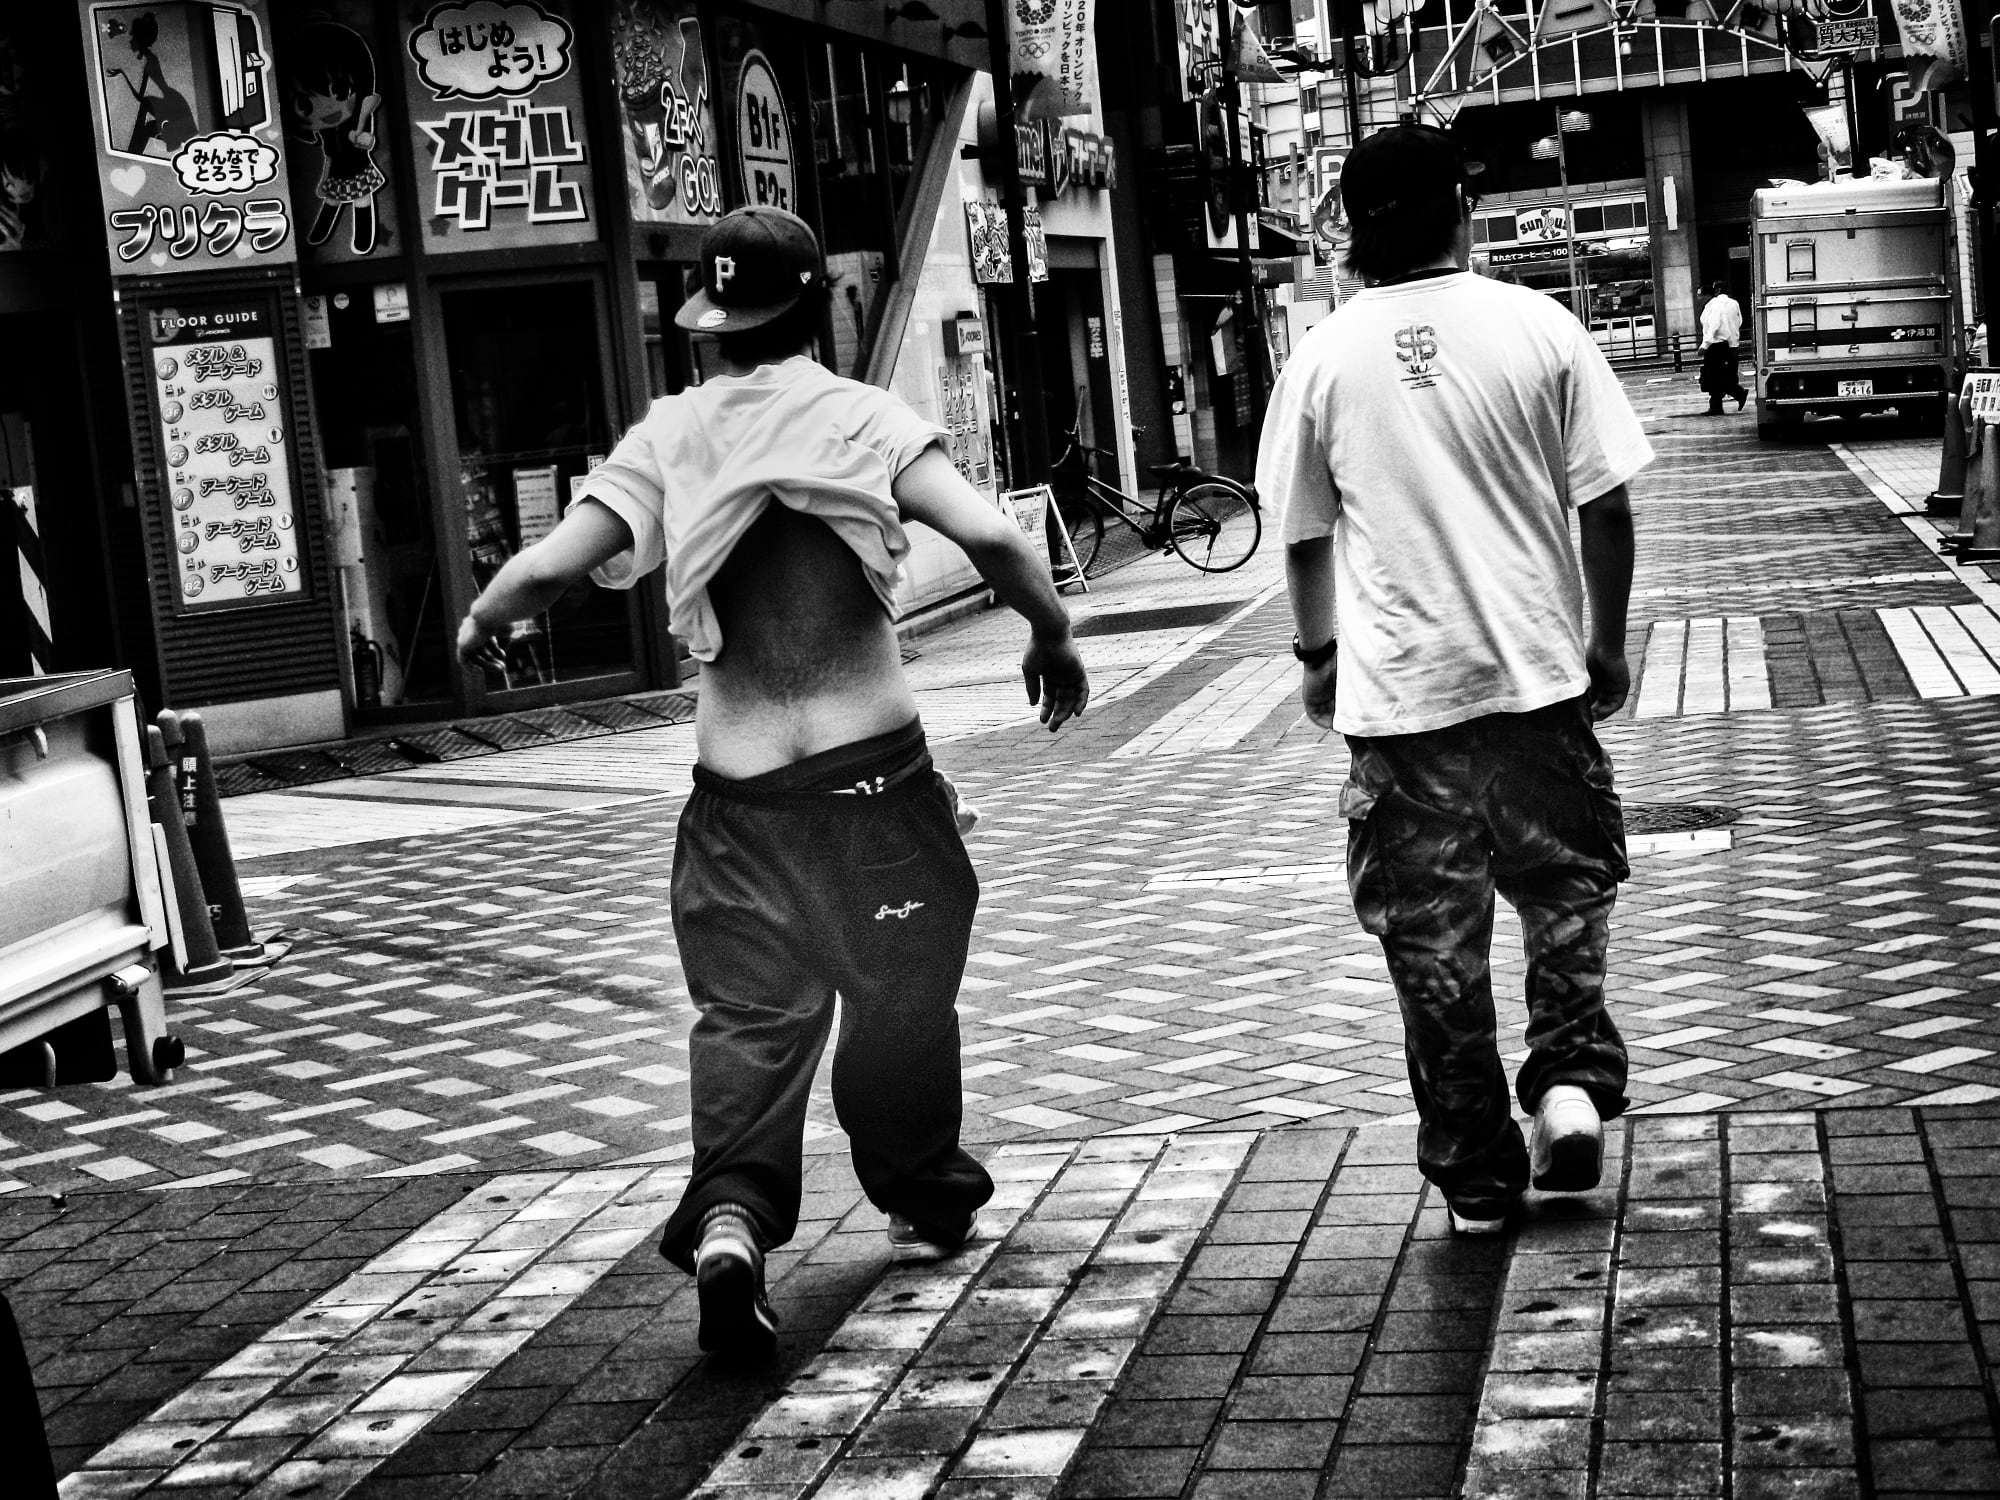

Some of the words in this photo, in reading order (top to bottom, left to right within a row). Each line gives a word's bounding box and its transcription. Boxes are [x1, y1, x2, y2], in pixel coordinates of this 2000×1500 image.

[438, 20, 516, 56] はじめ
[488, 44, 547, 78] よう!
[746, 92, 781, 150] B1F
[416, 99, 584, 171] メダル
[192, 148, 260, 166] みんなで
[195, 164, 256, 182] とろう!
[680, 154, 721, 213] GO!
[435, 159, 586, 229] ゲーム
[111, 199, 288, 261] プリクラ
[715, 256, 737, 293] P
[161, 315, 208, 329] FLOOR
[214, 311, 258, 324] GUIDE
[185, 346, 227, 367] メダル
[230, 345, 246, 362] &
[194, 359, 262, 382] アーケード
[190, 389, 233, 410] メダル
[224, 402, 265, 423] ゲーム
[195, 433, 239, 454] メダル
[170, 451, 185, 462] 2F
[229, 446, 270, 467] ゲーム
[200, 473, 267, 498] アーケード
[175, 494, 189, 506] 1F
[234, 489, 276, 510] ゲーム
[205, 516, 271, 541] アーケード
[239, 532, 280, 553] ゲーム
[210, 559, 277, 583] アーケード
[184, 580, 201, 592] B2
[245, 575, 286, 595] ゲーム
